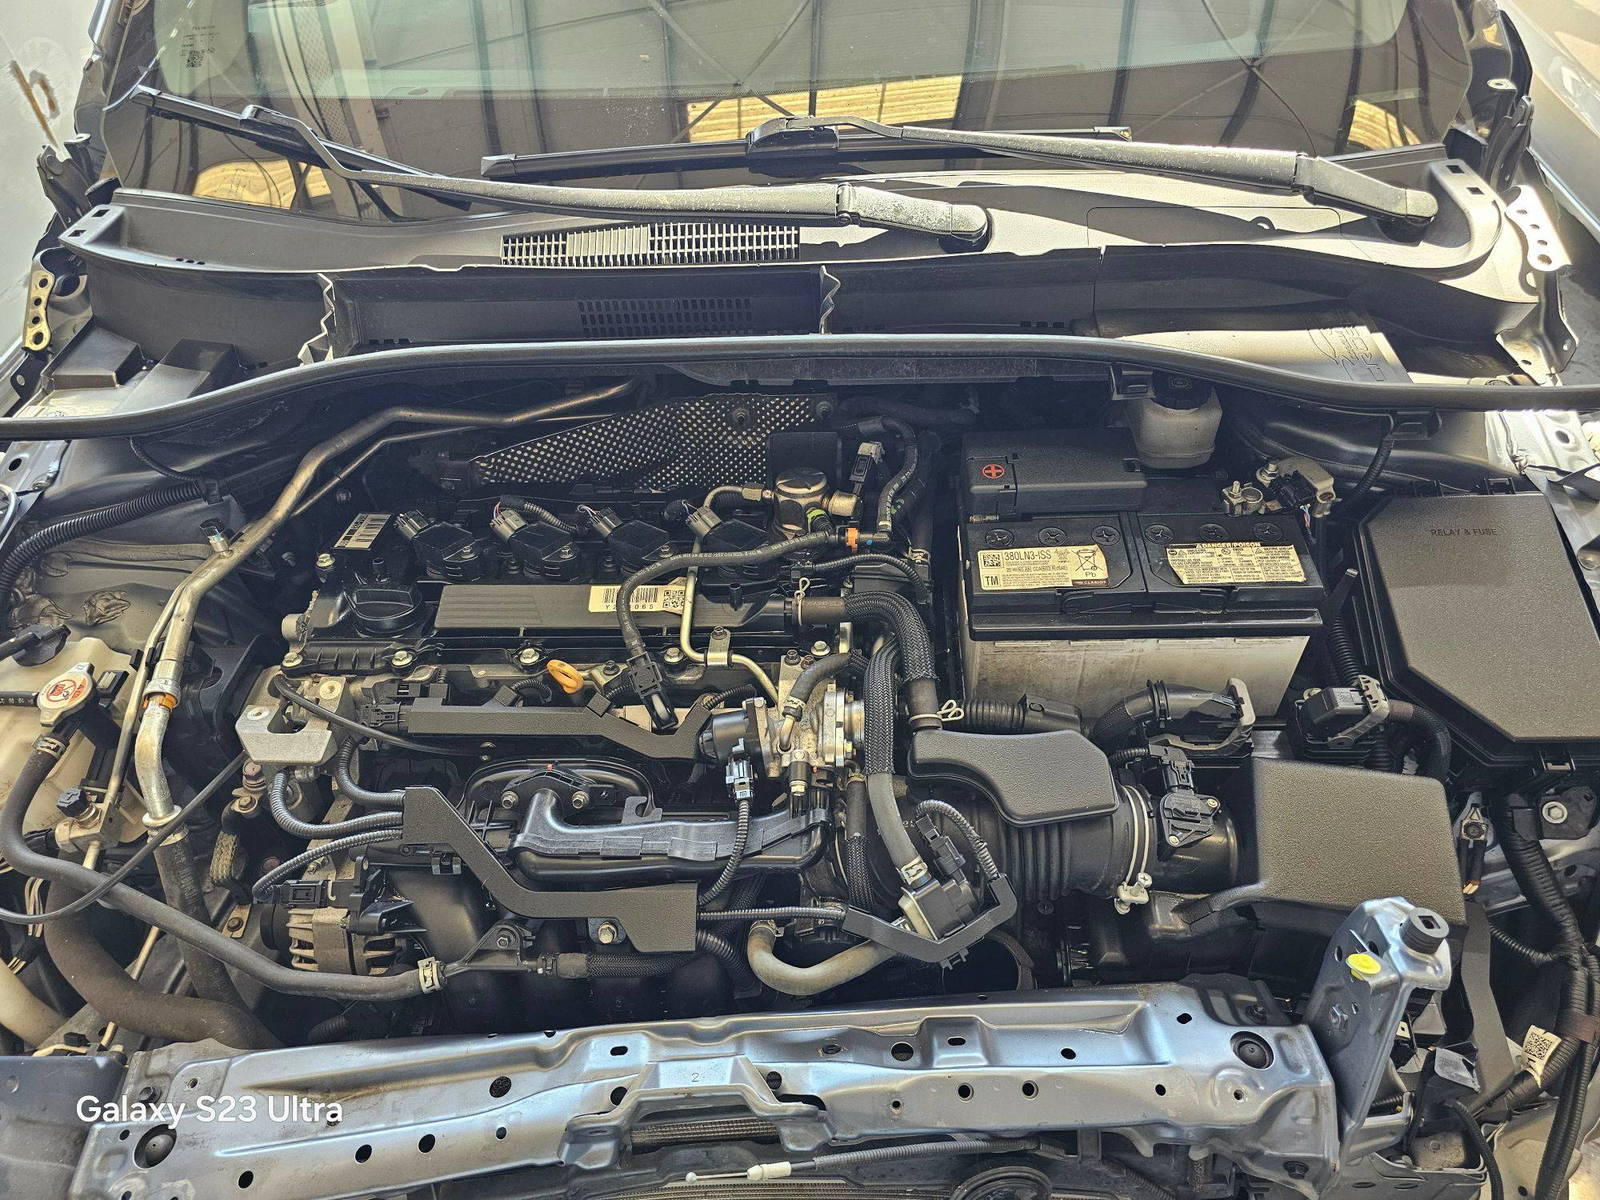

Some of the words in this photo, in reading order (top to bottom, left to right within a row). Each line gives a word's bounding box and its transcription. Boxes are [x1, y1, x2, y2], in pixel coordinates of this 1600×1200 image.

[1430, 528, 1460, 536] RELAY
[1464, 528, 1471, 536] &
[1473, 528, 1498, 536] FUSE
[1004, 550, 1052, 561] 380LN3-ISS
[985, 575, 999, 586] TM
[691, 1072, 700, 1083] 2
